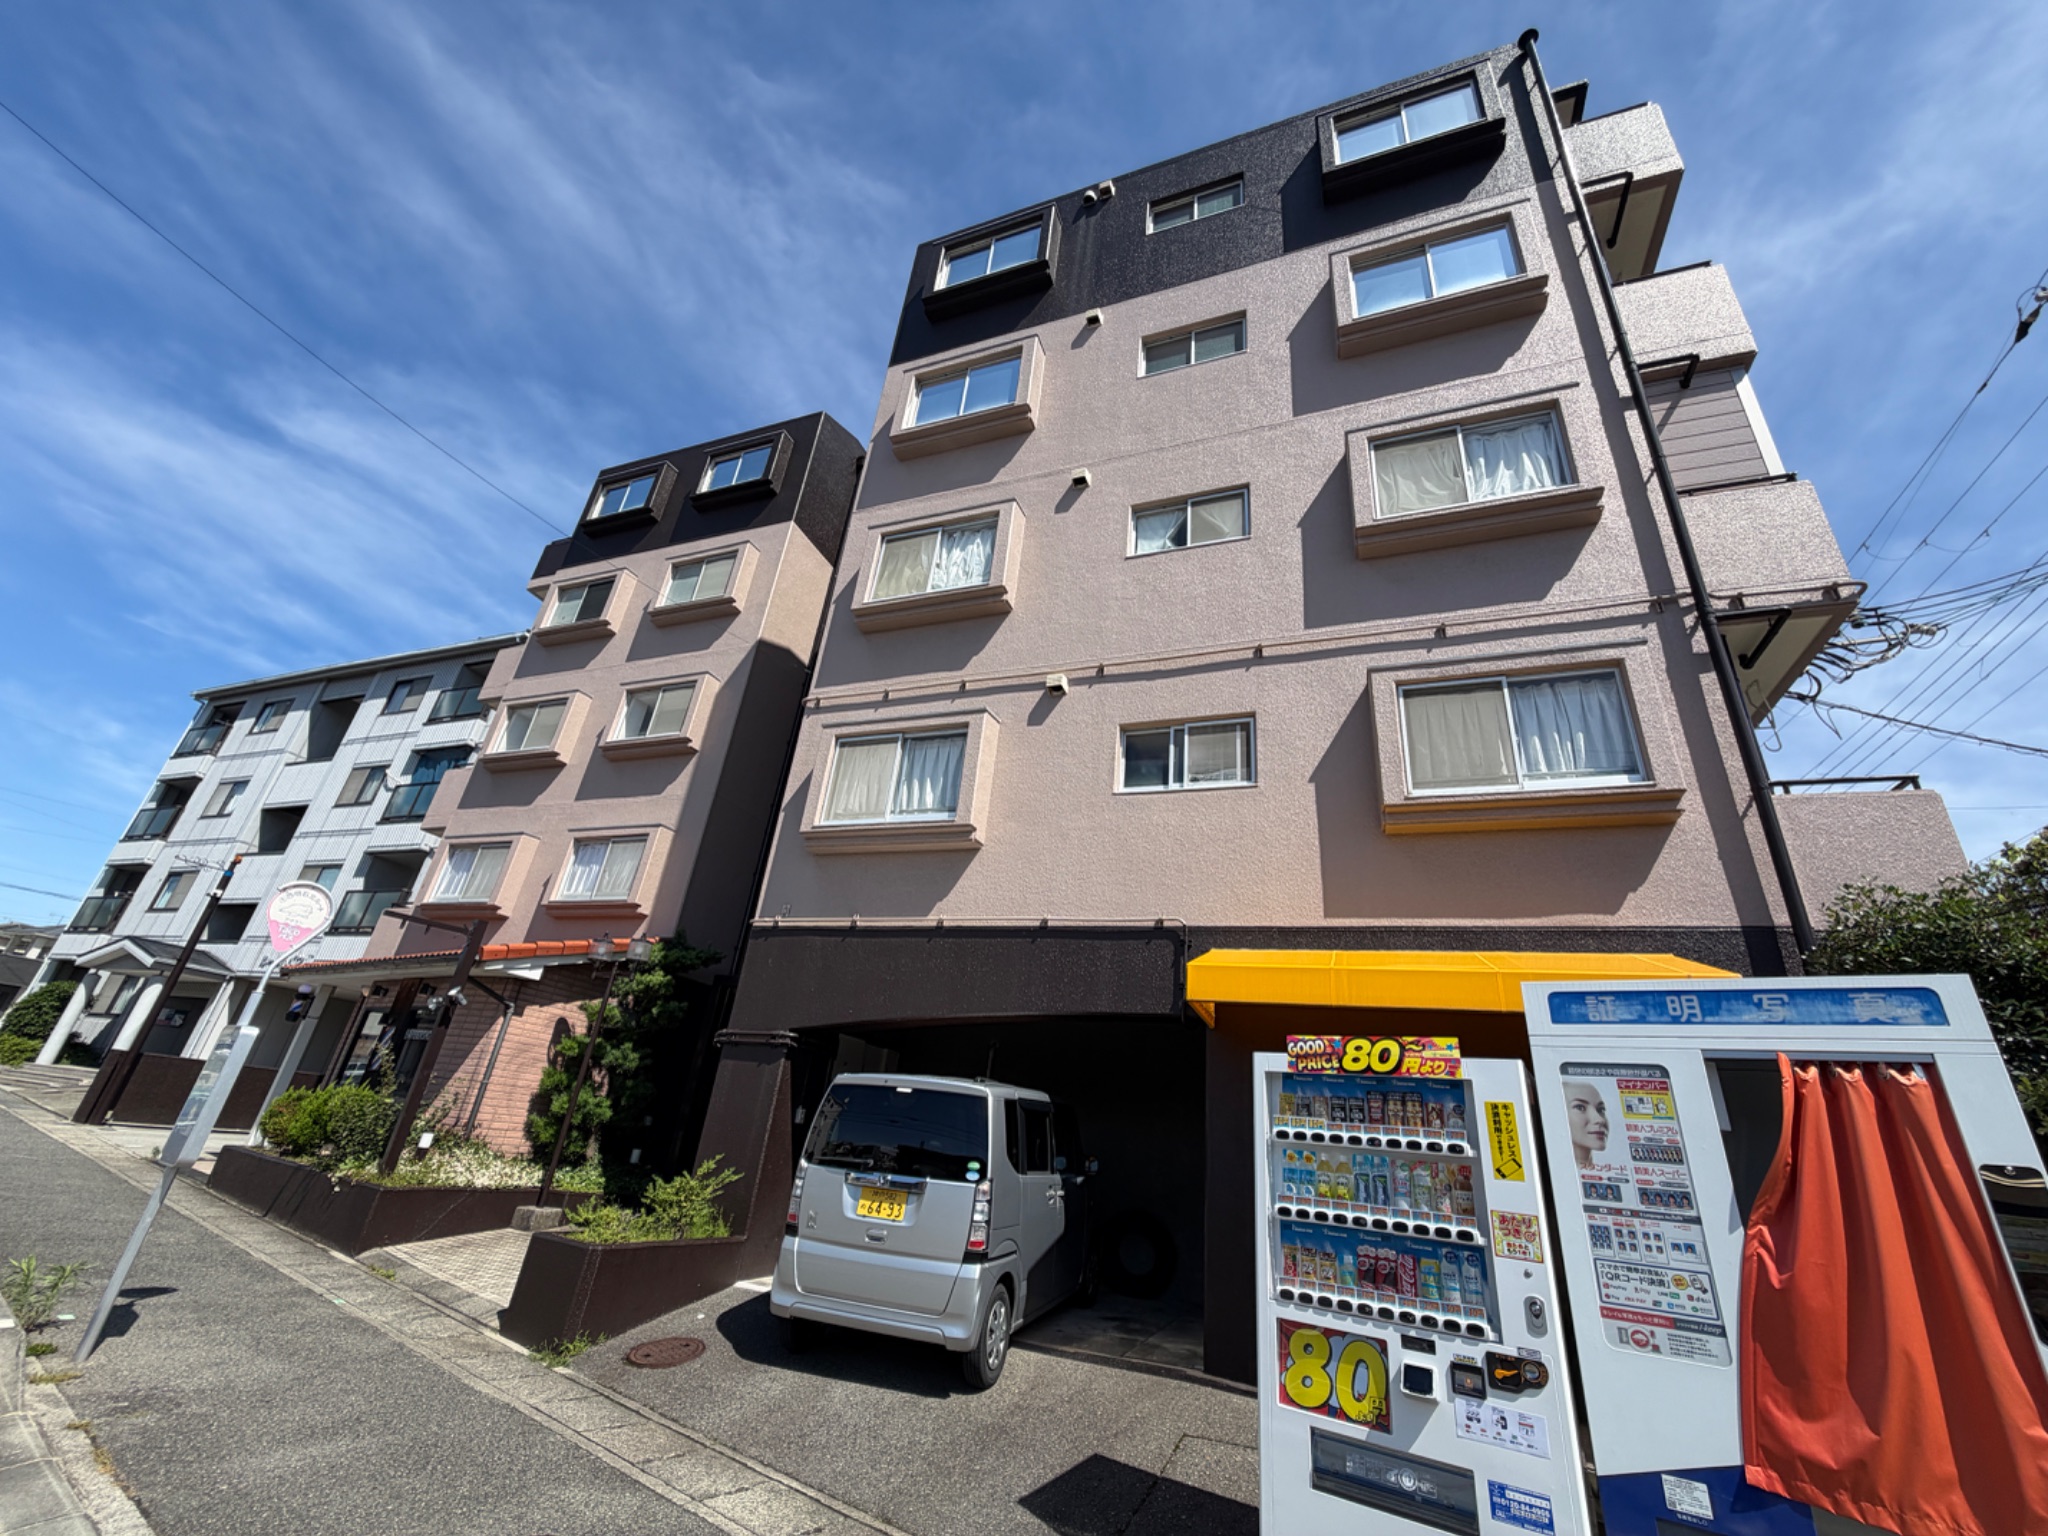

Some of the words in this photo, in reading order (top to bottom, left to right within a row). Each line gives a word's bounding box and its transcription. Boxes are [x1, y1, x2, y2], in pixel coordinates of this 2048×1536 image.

[1584, 993, 1893, 1023] 証明写真
[1287, 1039, 1325, 1057] GOOD
[1341, 1038, 1400, 1073] 80
[1297, 1055, 1341, 1071] PRICE
[1402, 1058, 1446, 1074] 円より
[1617, 1080, 1669, 1091] マイナンバー
[1501, 1103, 1517, 1158] キャッシュレス
[1580, 1163, 1628, 1174] スタンダード
[867, 1199, 903, 1218] 64-93
[1499, 1214, 1533, 1229] あたり
[1499, 1226, 1522, 1239] つき
[1286, 1328, 1387, 1422] 80
